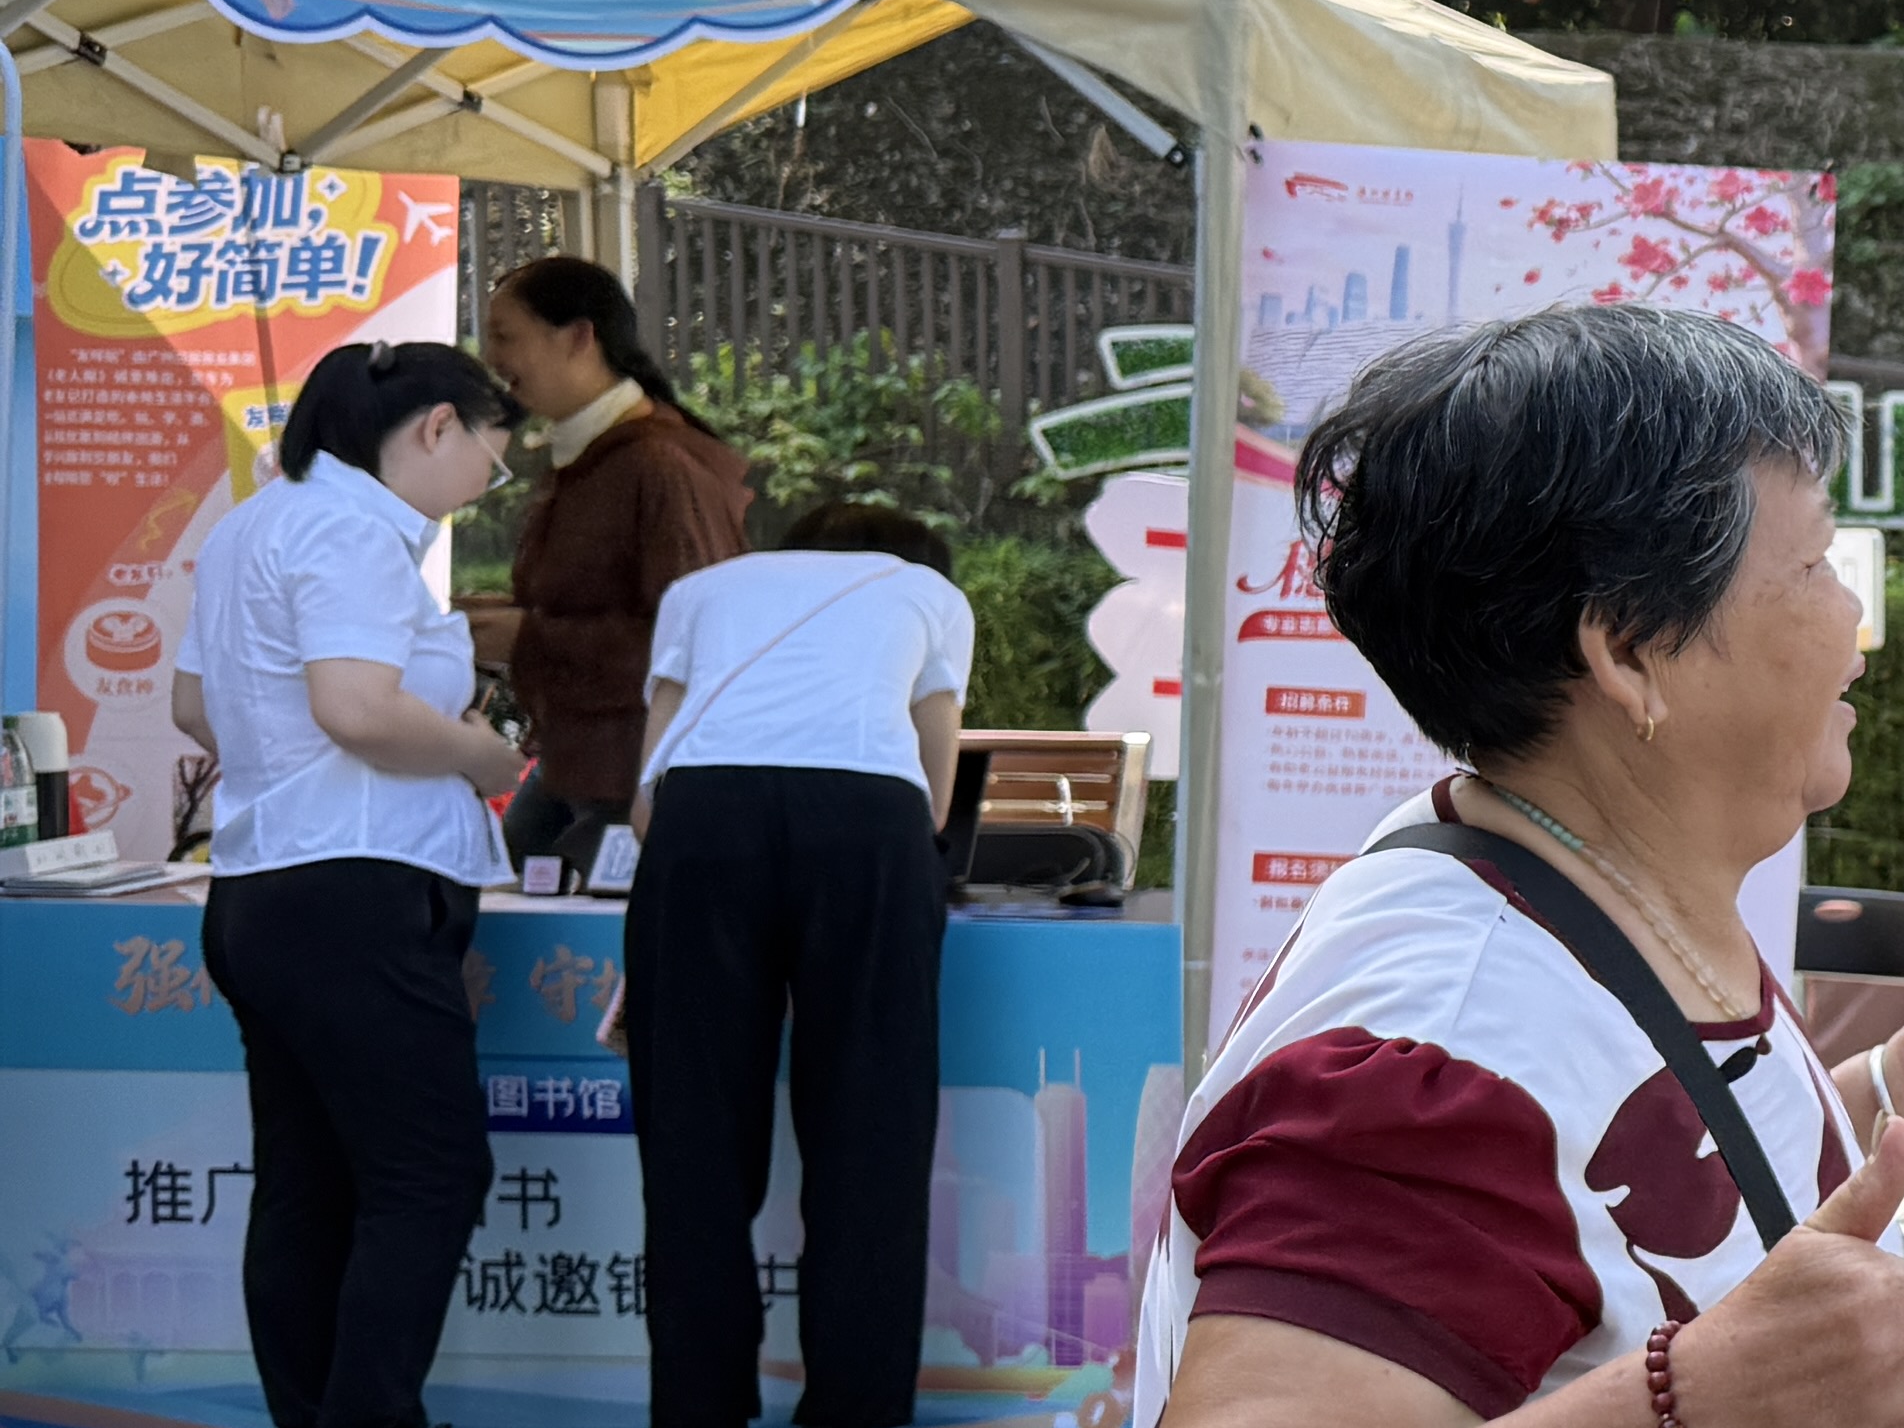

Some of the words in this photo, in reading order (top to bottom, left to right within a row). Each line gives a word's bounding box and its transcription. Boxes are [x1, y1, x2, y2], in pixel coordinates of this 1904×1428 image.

[127, 230, 387, 310] 好简单！
[487, 1073, 623, 1121] 图书馆
[123, 1157, 256, 1227] 推广
